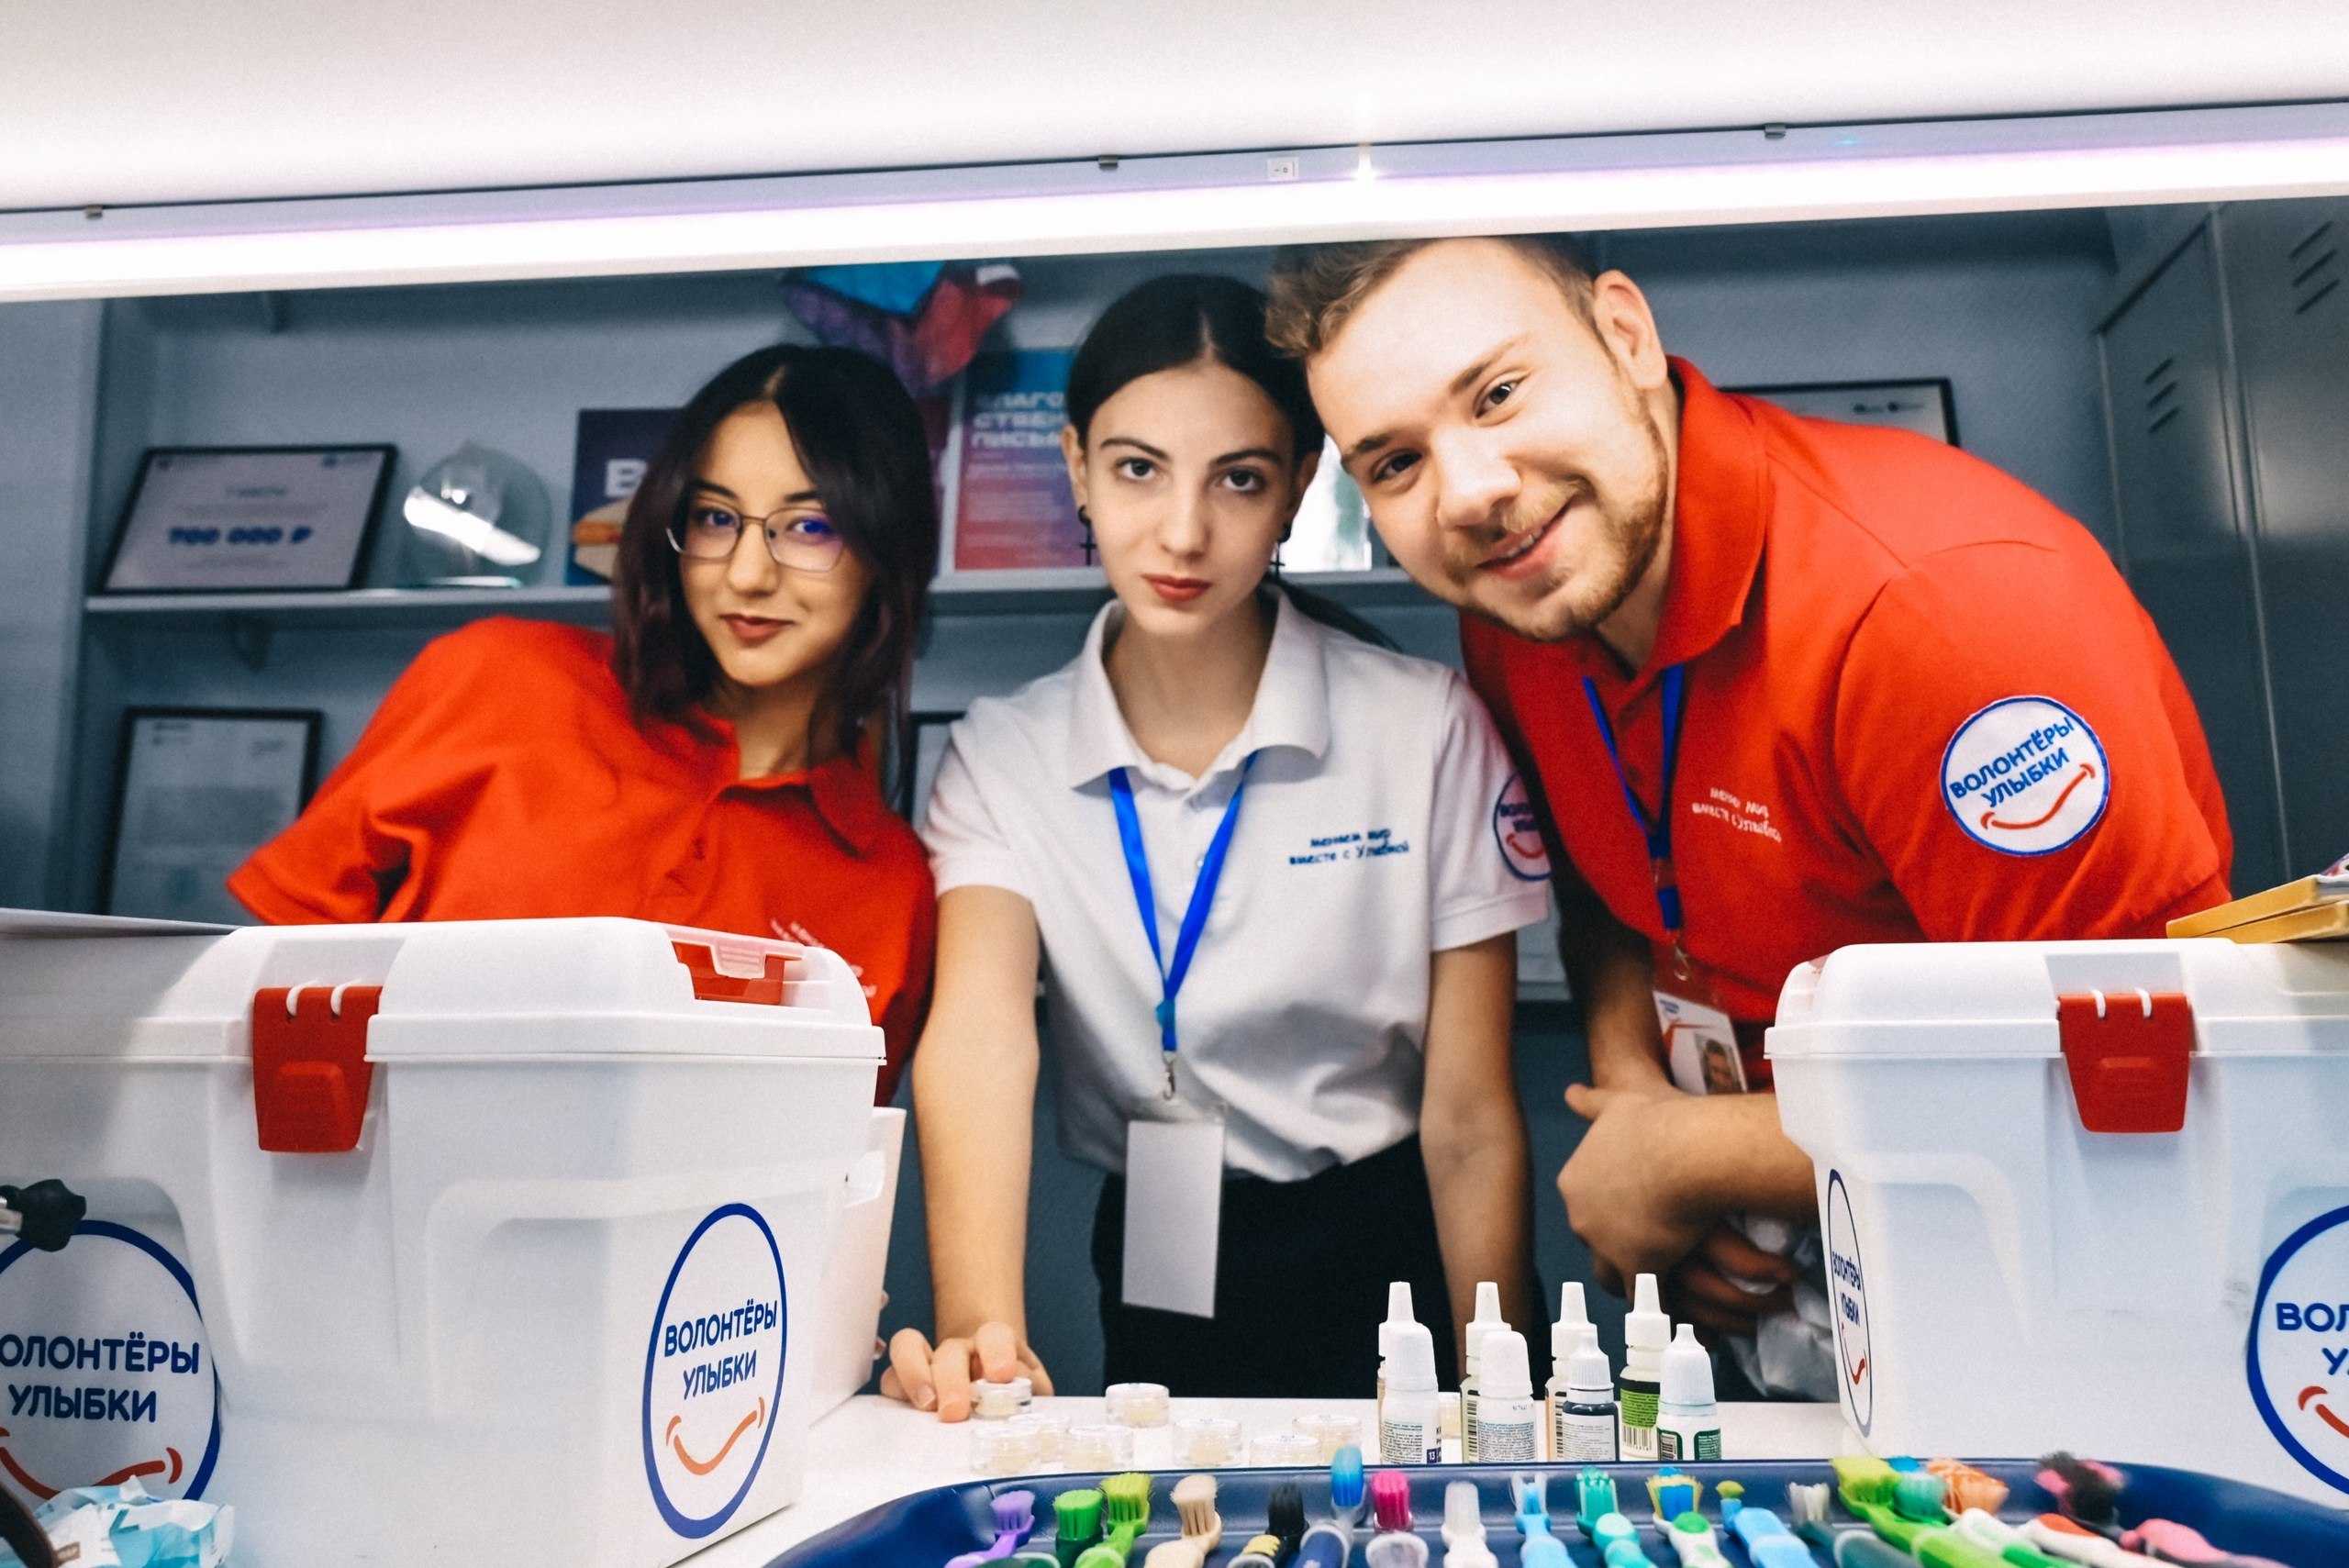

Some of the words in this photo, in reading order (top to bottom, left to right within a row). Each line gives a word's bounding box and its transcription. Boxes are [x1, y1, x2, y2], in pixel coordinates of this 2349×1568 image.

[1949, 717, 2075, 799] ВОЛОНТЁРЫ
[1981, 747, 2070, 807] УЛЫБКИ
[663, 1298, 777, 1358] ВОЛОНТЁРЫ
[8, 1384, 157, 1423] УЛЫБКИ
[683, 1349, 757, 1400] УЛЫБКИ
